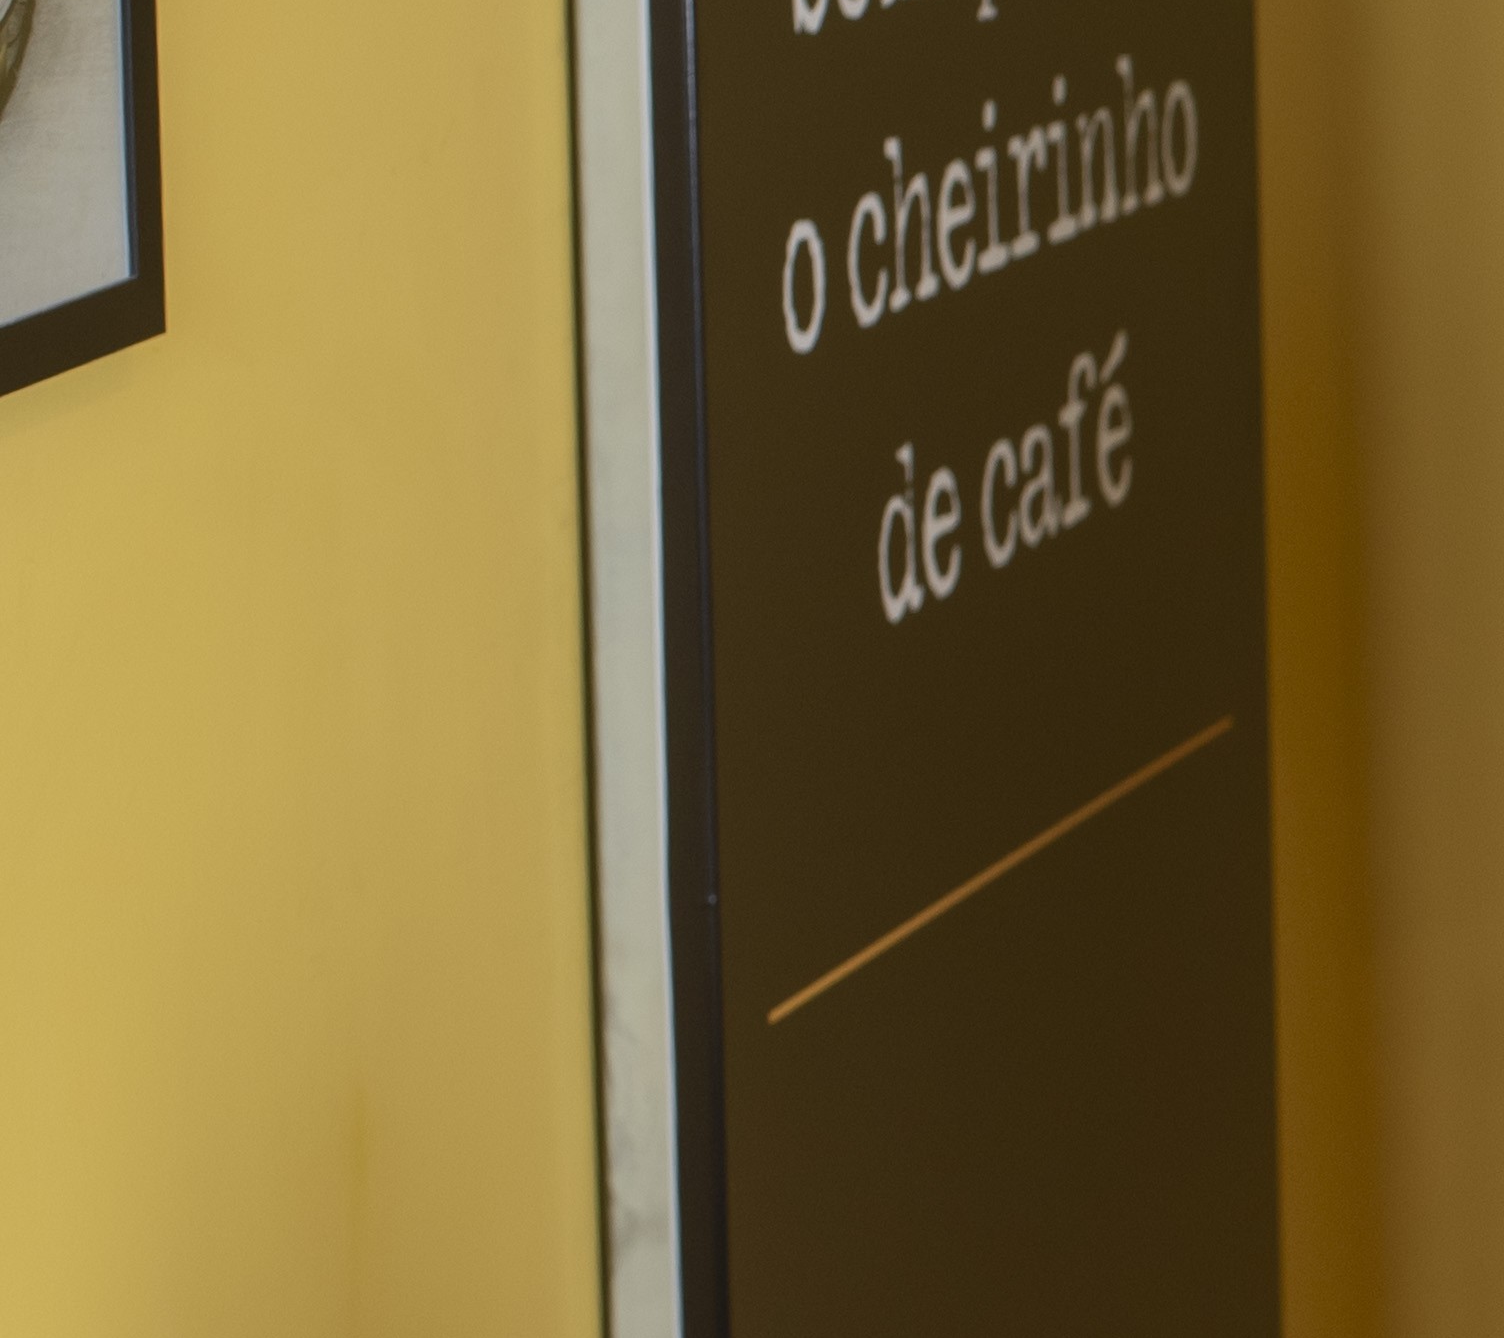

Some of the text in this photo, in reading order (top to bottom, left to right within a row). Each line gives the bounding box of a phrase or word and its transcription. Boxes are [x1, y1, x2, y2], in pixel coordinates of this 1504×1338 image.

[782, 54, 1199, 355] o cheirinho
[877, 329, 1134, 624] de café
